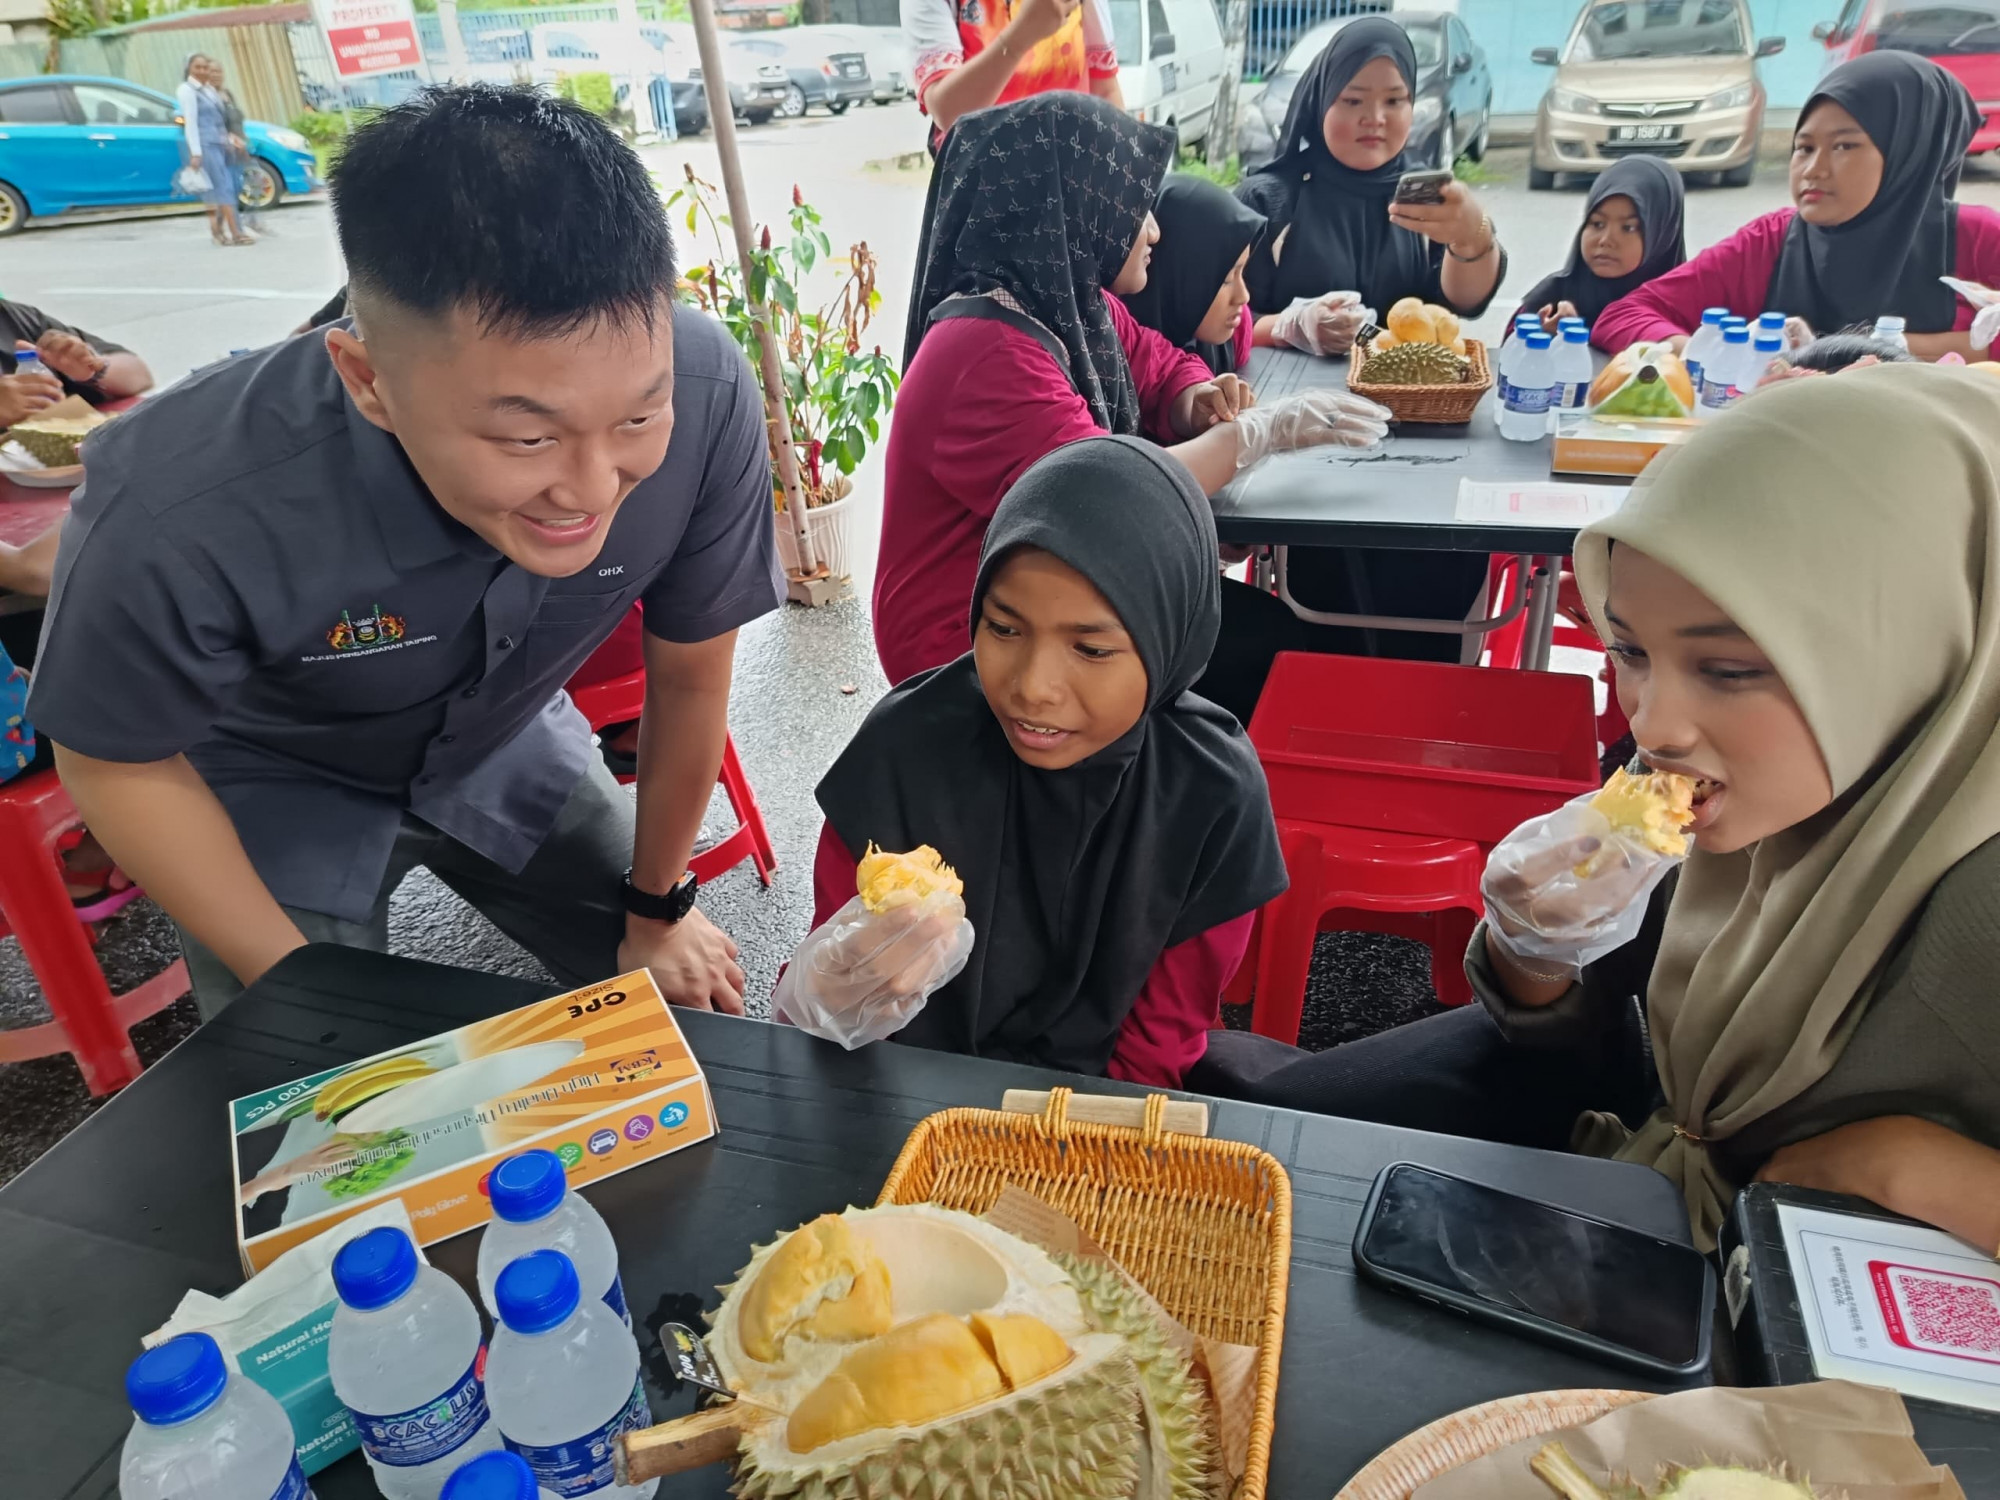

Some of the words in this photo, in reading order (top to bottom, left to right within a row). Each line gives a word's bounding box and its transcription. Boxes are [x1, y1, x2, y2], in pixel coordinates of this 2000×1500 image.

[598, 565, 624, 577] OHX
[403, 634, 438, 648] TAIPING
[567, 991, 627, 1019] CPE
[617, 1056, 653, 1074] KBM
[278, 1081, 311, 1101] 100
[562, 1072, 601, 1095] High
[255, 1330, 311, 1365] Natural
[284, 1345, 307, 1361] Soft
[296, 1421, 348, 1458] Natural
